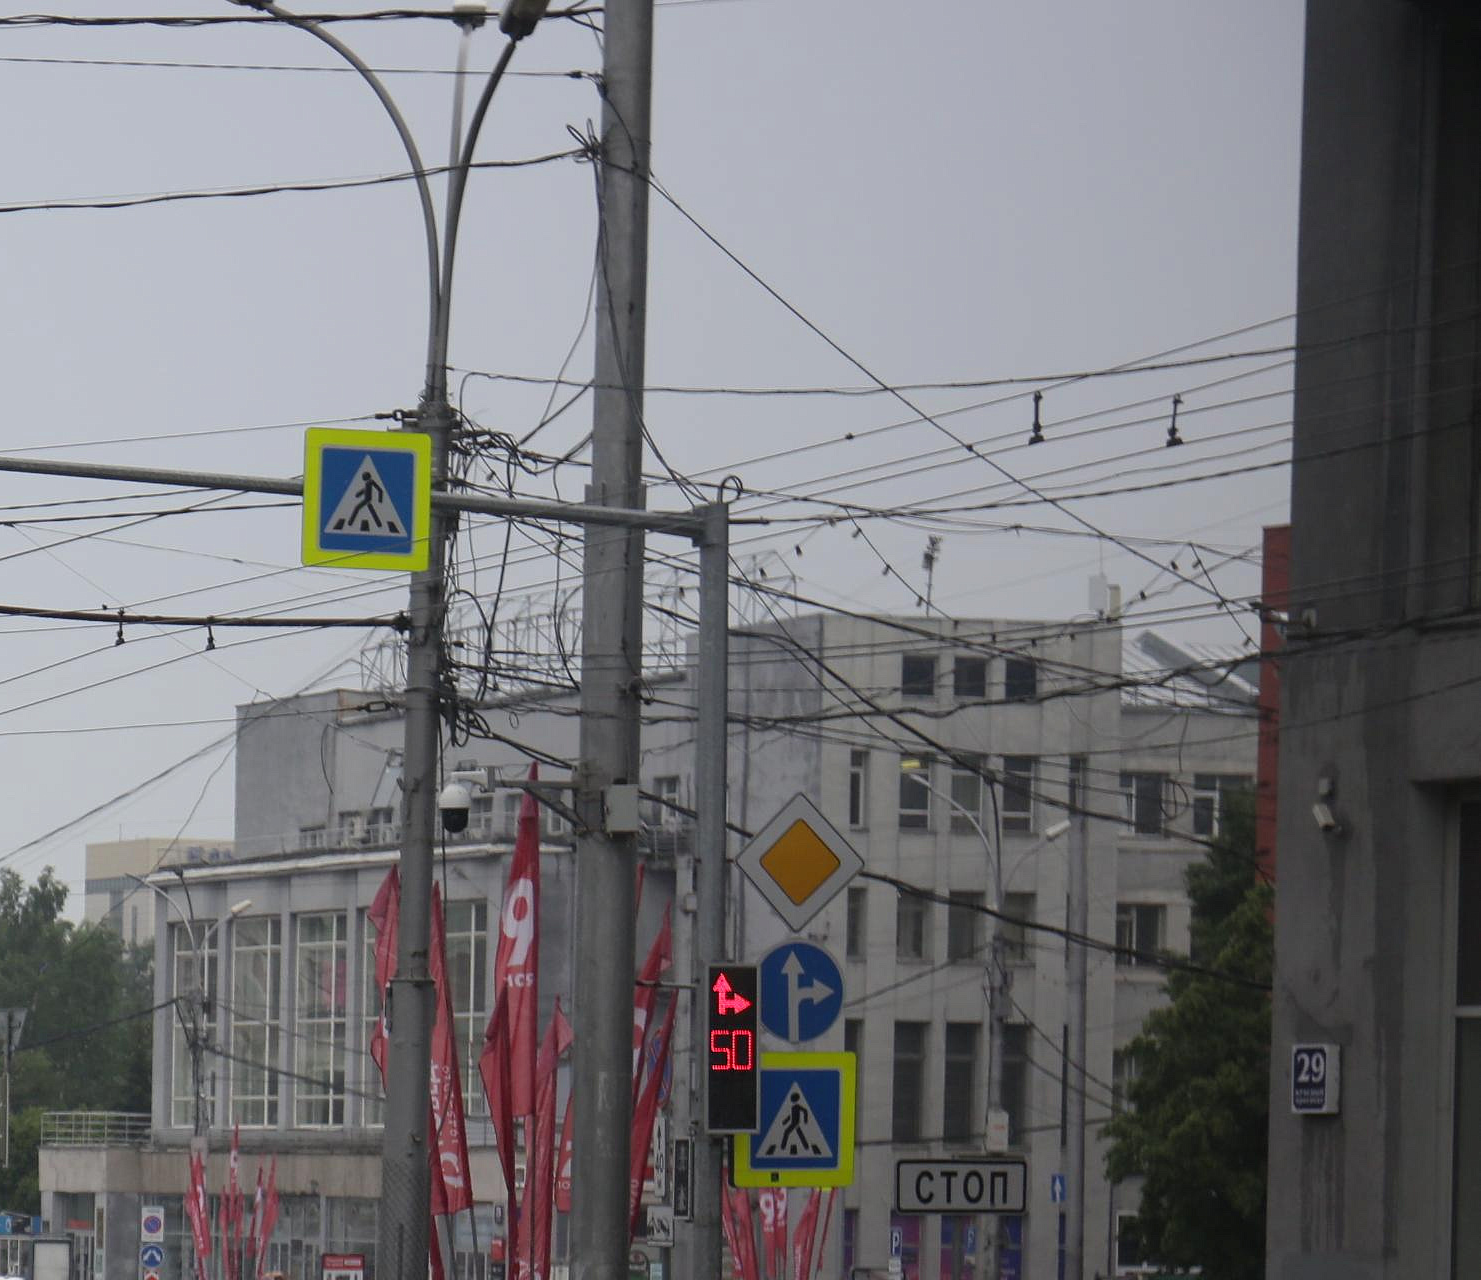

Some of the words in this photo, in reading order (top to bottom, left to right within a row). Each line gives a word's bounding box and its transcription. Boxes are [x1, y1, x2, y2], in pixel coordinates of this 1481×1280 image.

[710, 1029, 752, 1071] 50
[1297, 1052, 1325, 1082] 29
[915, 1170, 1008, 1206] СТОП
